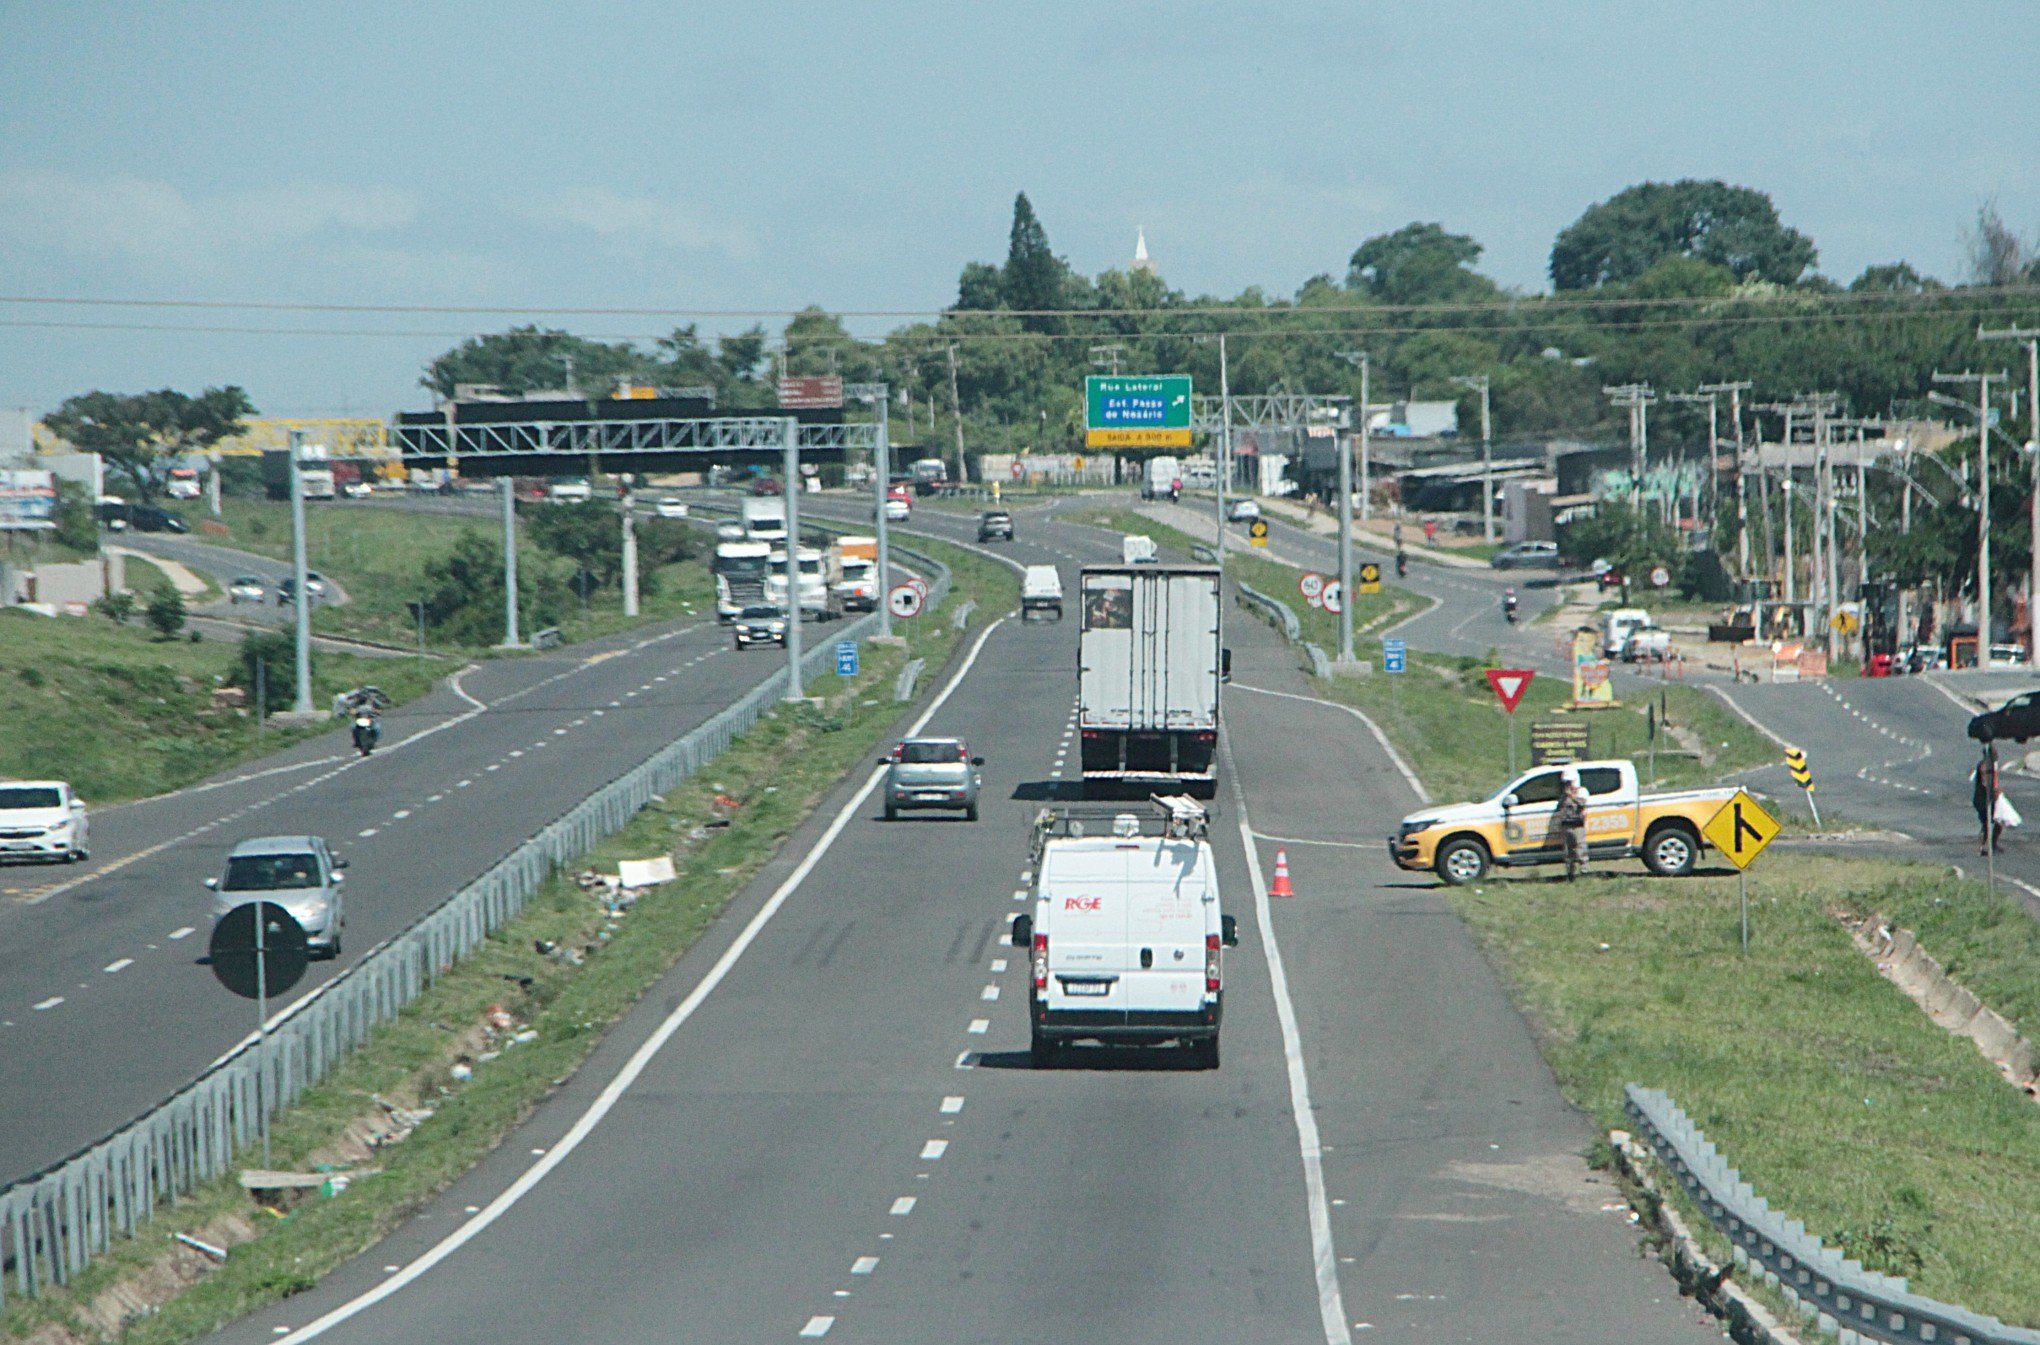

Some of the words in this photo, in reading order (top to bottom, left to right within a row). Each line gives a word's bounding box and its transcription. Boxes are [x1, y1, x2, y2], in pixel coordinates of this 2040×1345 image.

[1100, 382, 1120, 392] Rua
[1125, 382, 1163, 392] Lateral
[1132, 398, 1163, 408] Passo
[1105, 410, 1118, 420] do
[1122, 409, 1163, 420] Nazário
[1065, 896, 1102, 911] RGE
